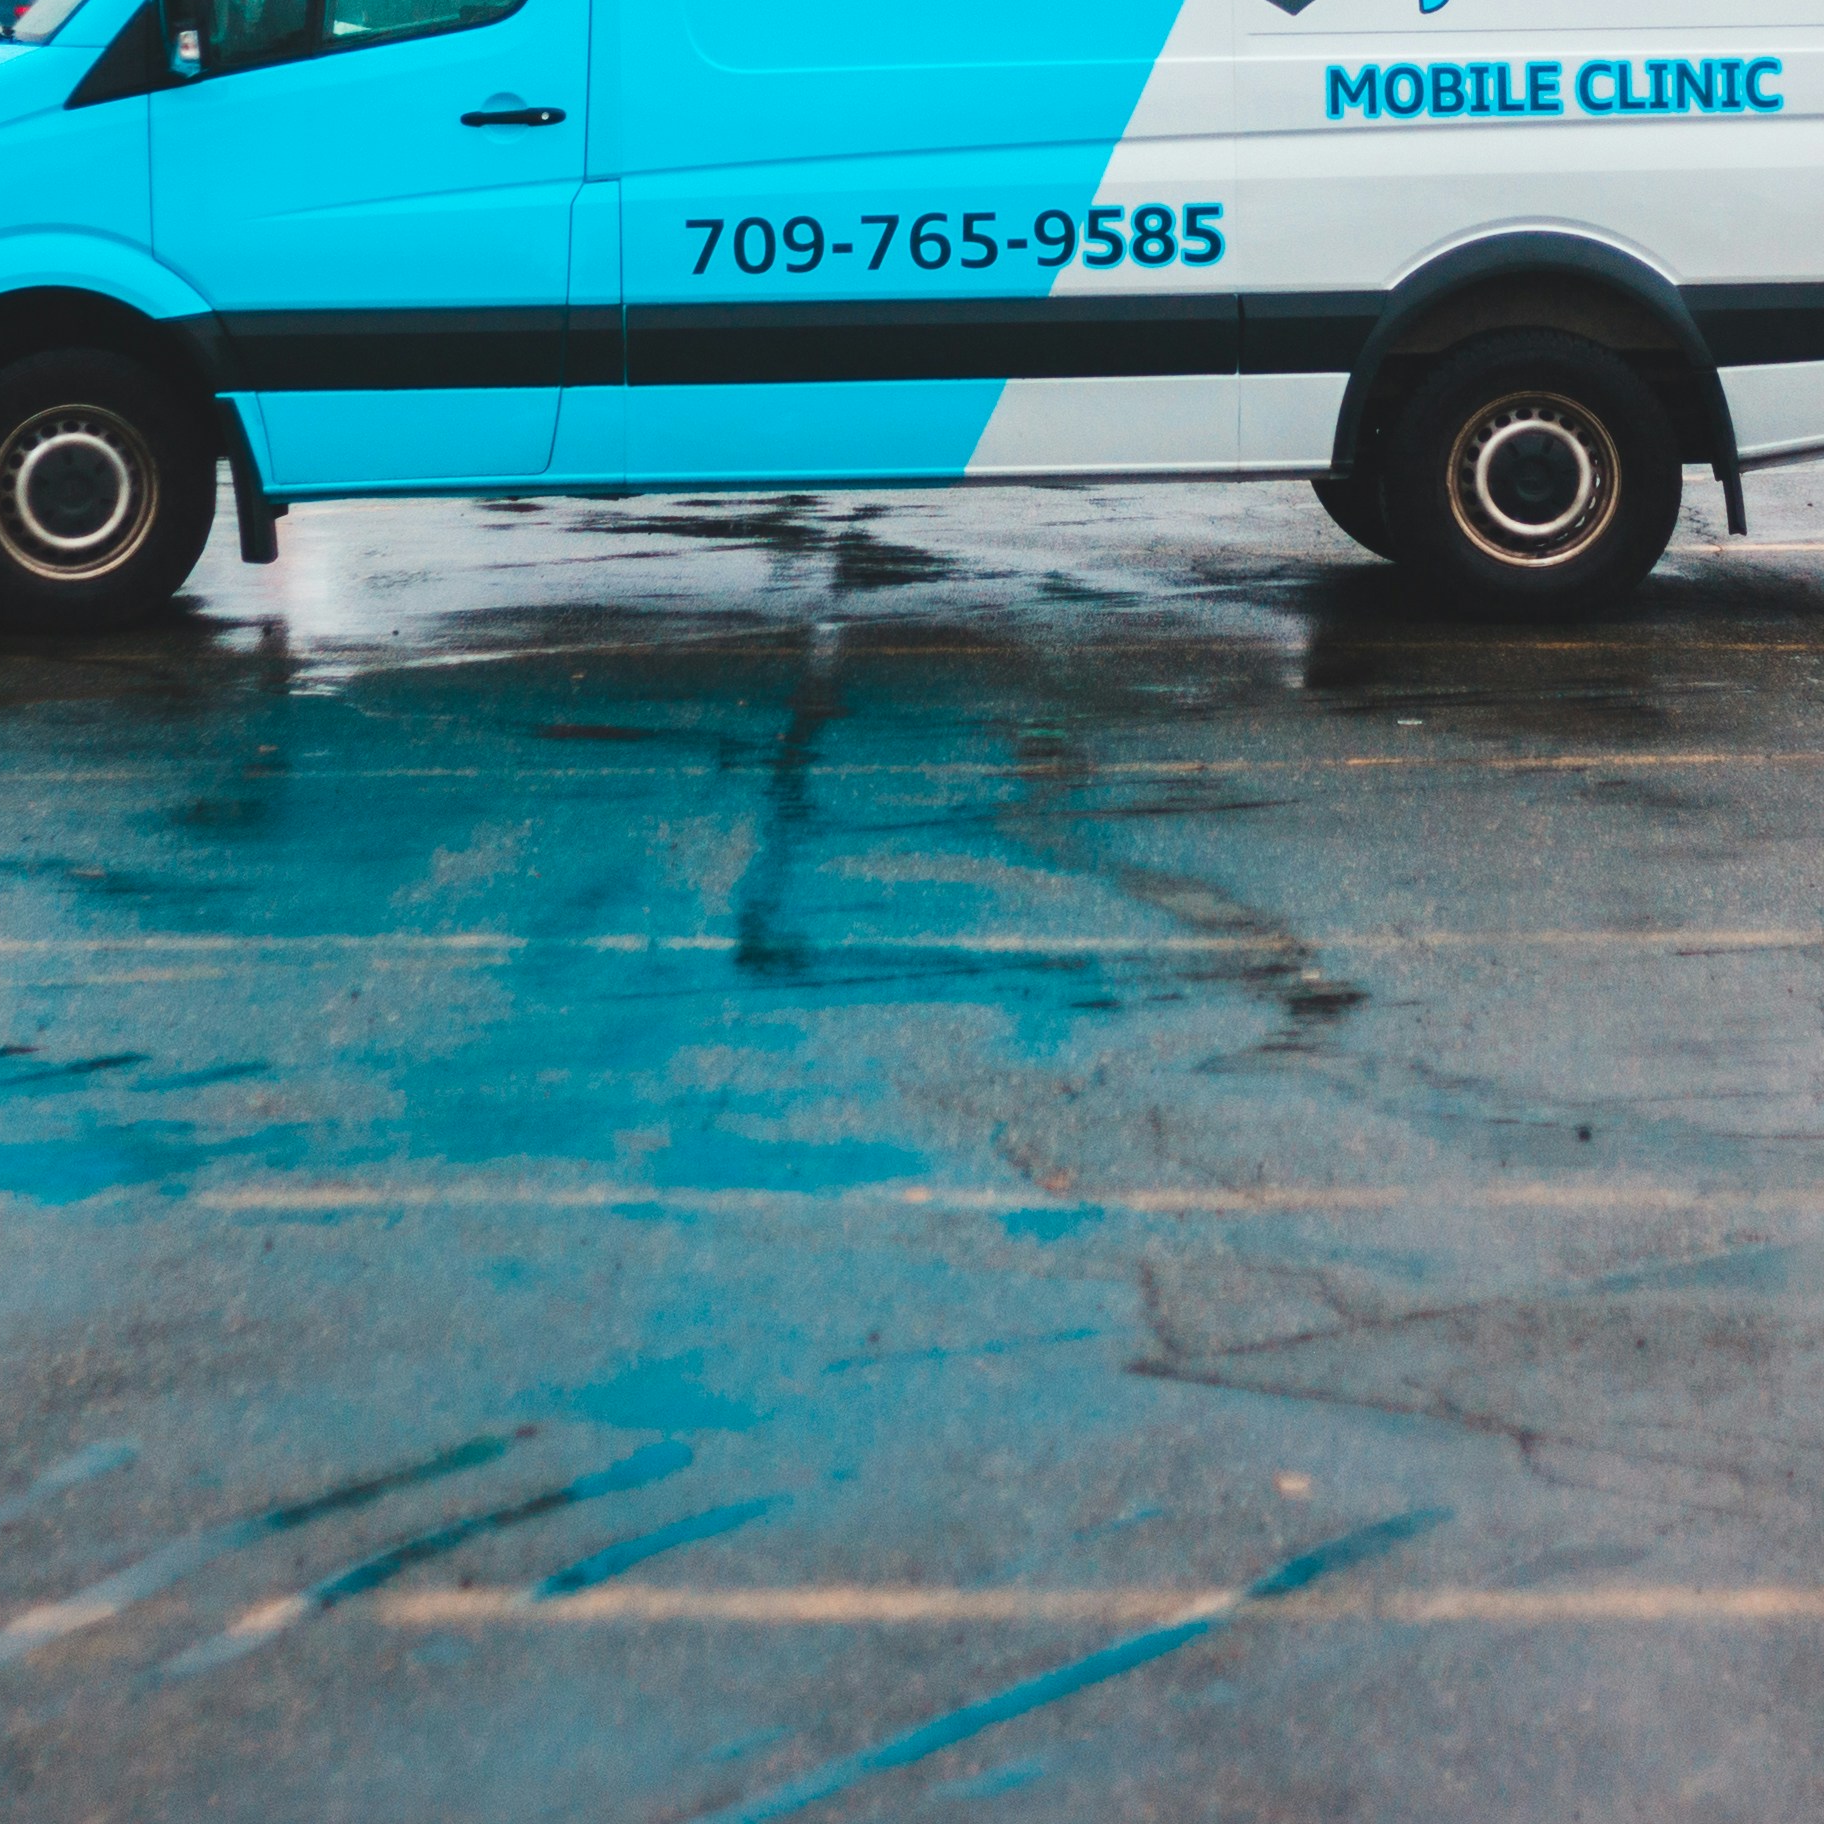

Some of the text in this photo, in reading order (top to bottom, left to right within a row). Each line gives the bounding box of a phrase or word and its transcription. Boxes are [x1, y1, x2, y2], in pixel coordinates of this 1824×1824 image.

[1326, 58, 1784, 119] MOBILE CLINIC
[684, 202, 1227, 276] 709-765-9585
